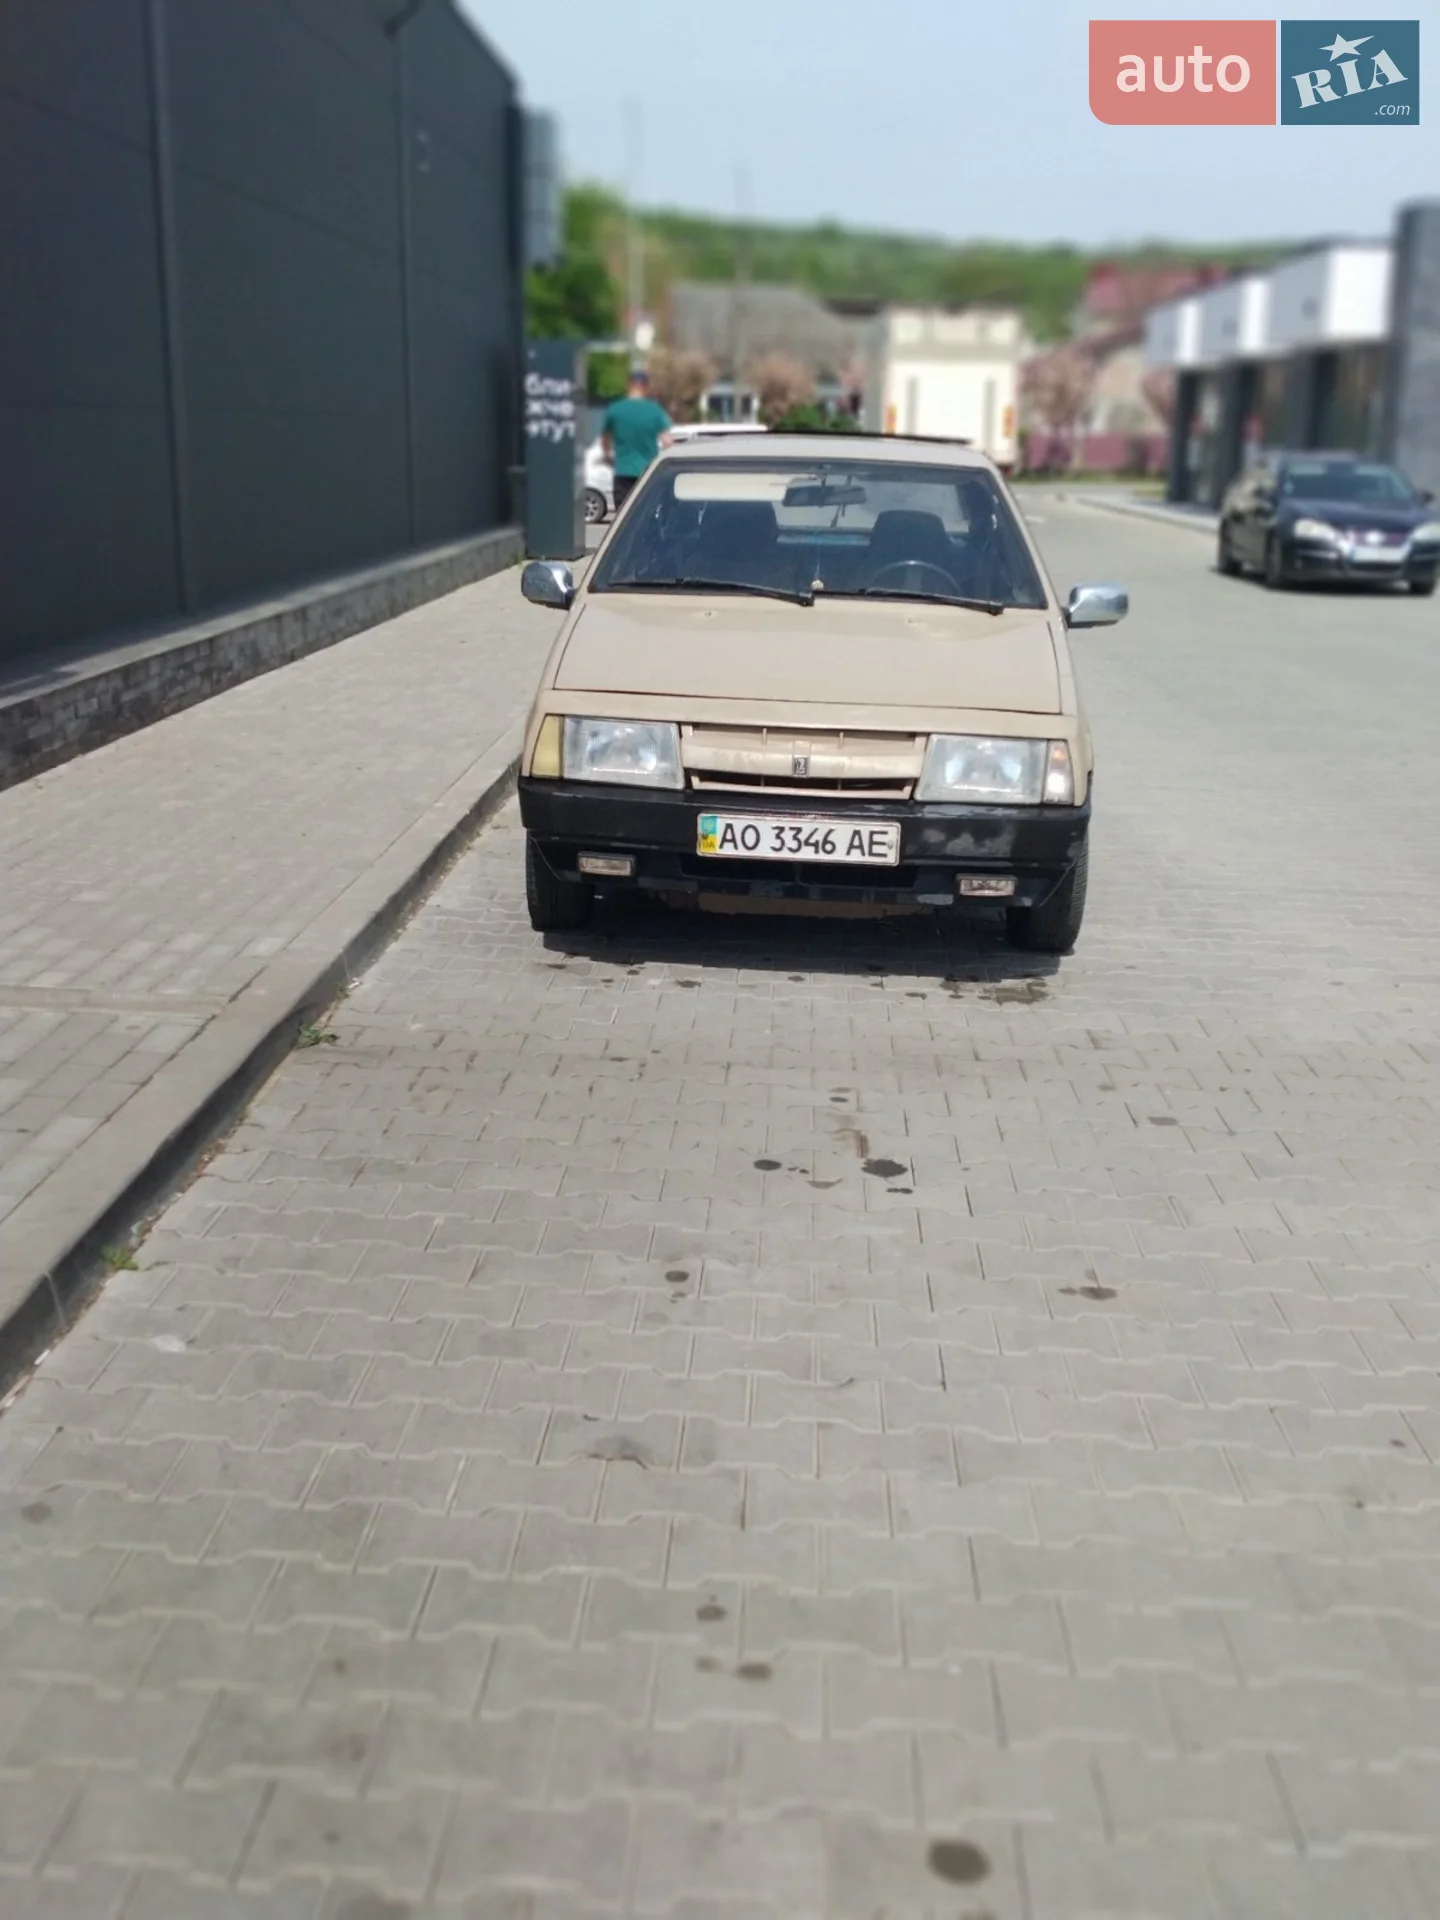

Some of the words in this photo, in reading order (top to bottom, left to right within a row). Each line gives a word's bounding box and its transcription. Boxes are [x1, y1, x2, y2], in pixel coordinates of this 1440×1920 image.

[719, 822, 761, 851] AO
[770, 825, 836, 855] 3346
[846, 829, 889, 858] AE
